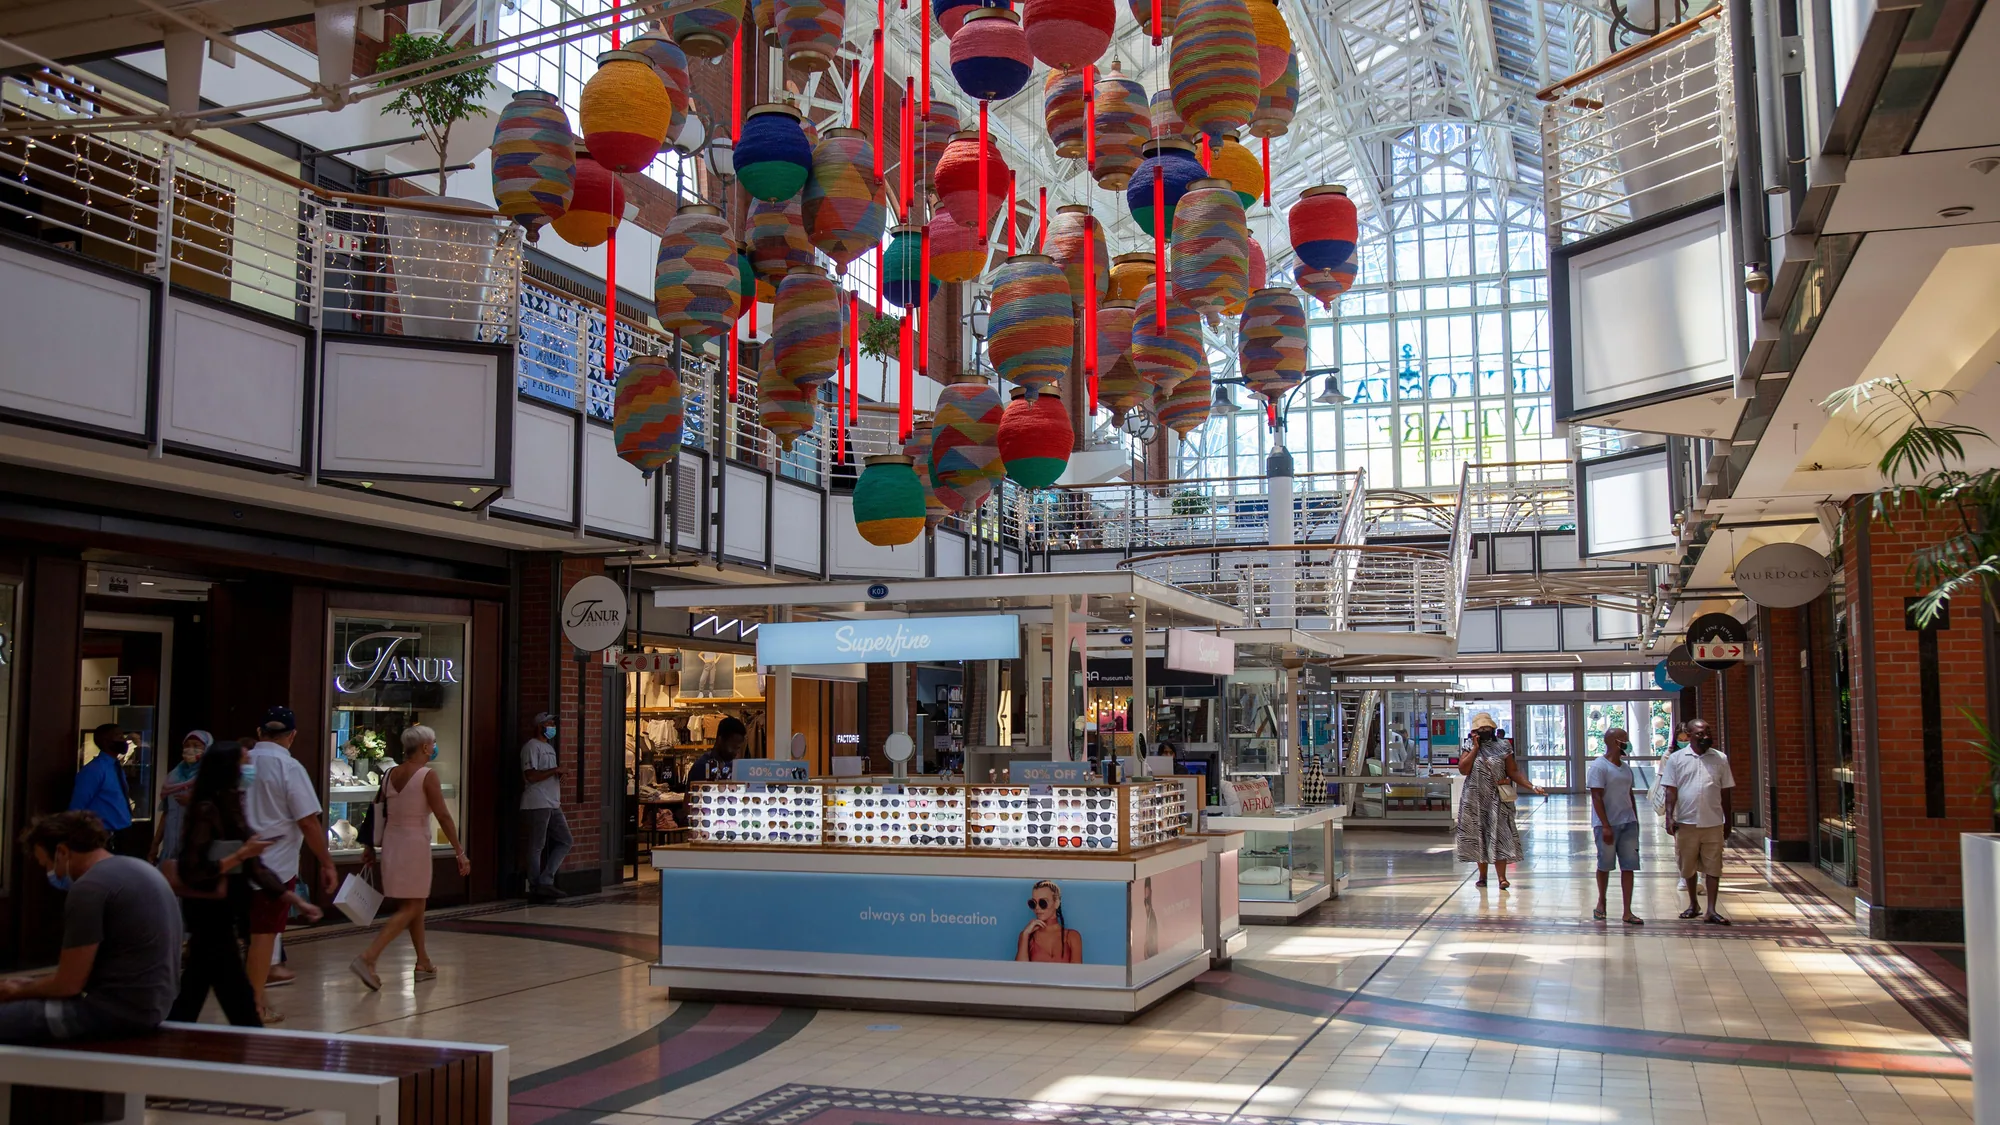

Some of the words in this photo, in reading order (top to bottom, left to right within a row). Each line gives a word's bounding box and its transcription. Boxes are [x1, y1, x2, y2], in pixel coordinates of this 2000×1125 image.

[532, 380, 571, 399] FABIANI
[1739, 570, 1829, 580] MURDOCKS
[566, 599, 619, 628] TANUR
[835, 623, 931, 658] Superfine
[335, 631, 459, 694] TANUR
[837, 734, 860, 743] FACTORIE
[749, 766, 773, 777] 30%
[1023, 768, 1051, 779] 30%
[1054, 768, 1077, 779] OFF
[1241, 796, 1275, 812] AFRICA
[859, 907, 905, 926] always
[909, 913, 926, 923] on
[930, 909, 997, 926] baecation
